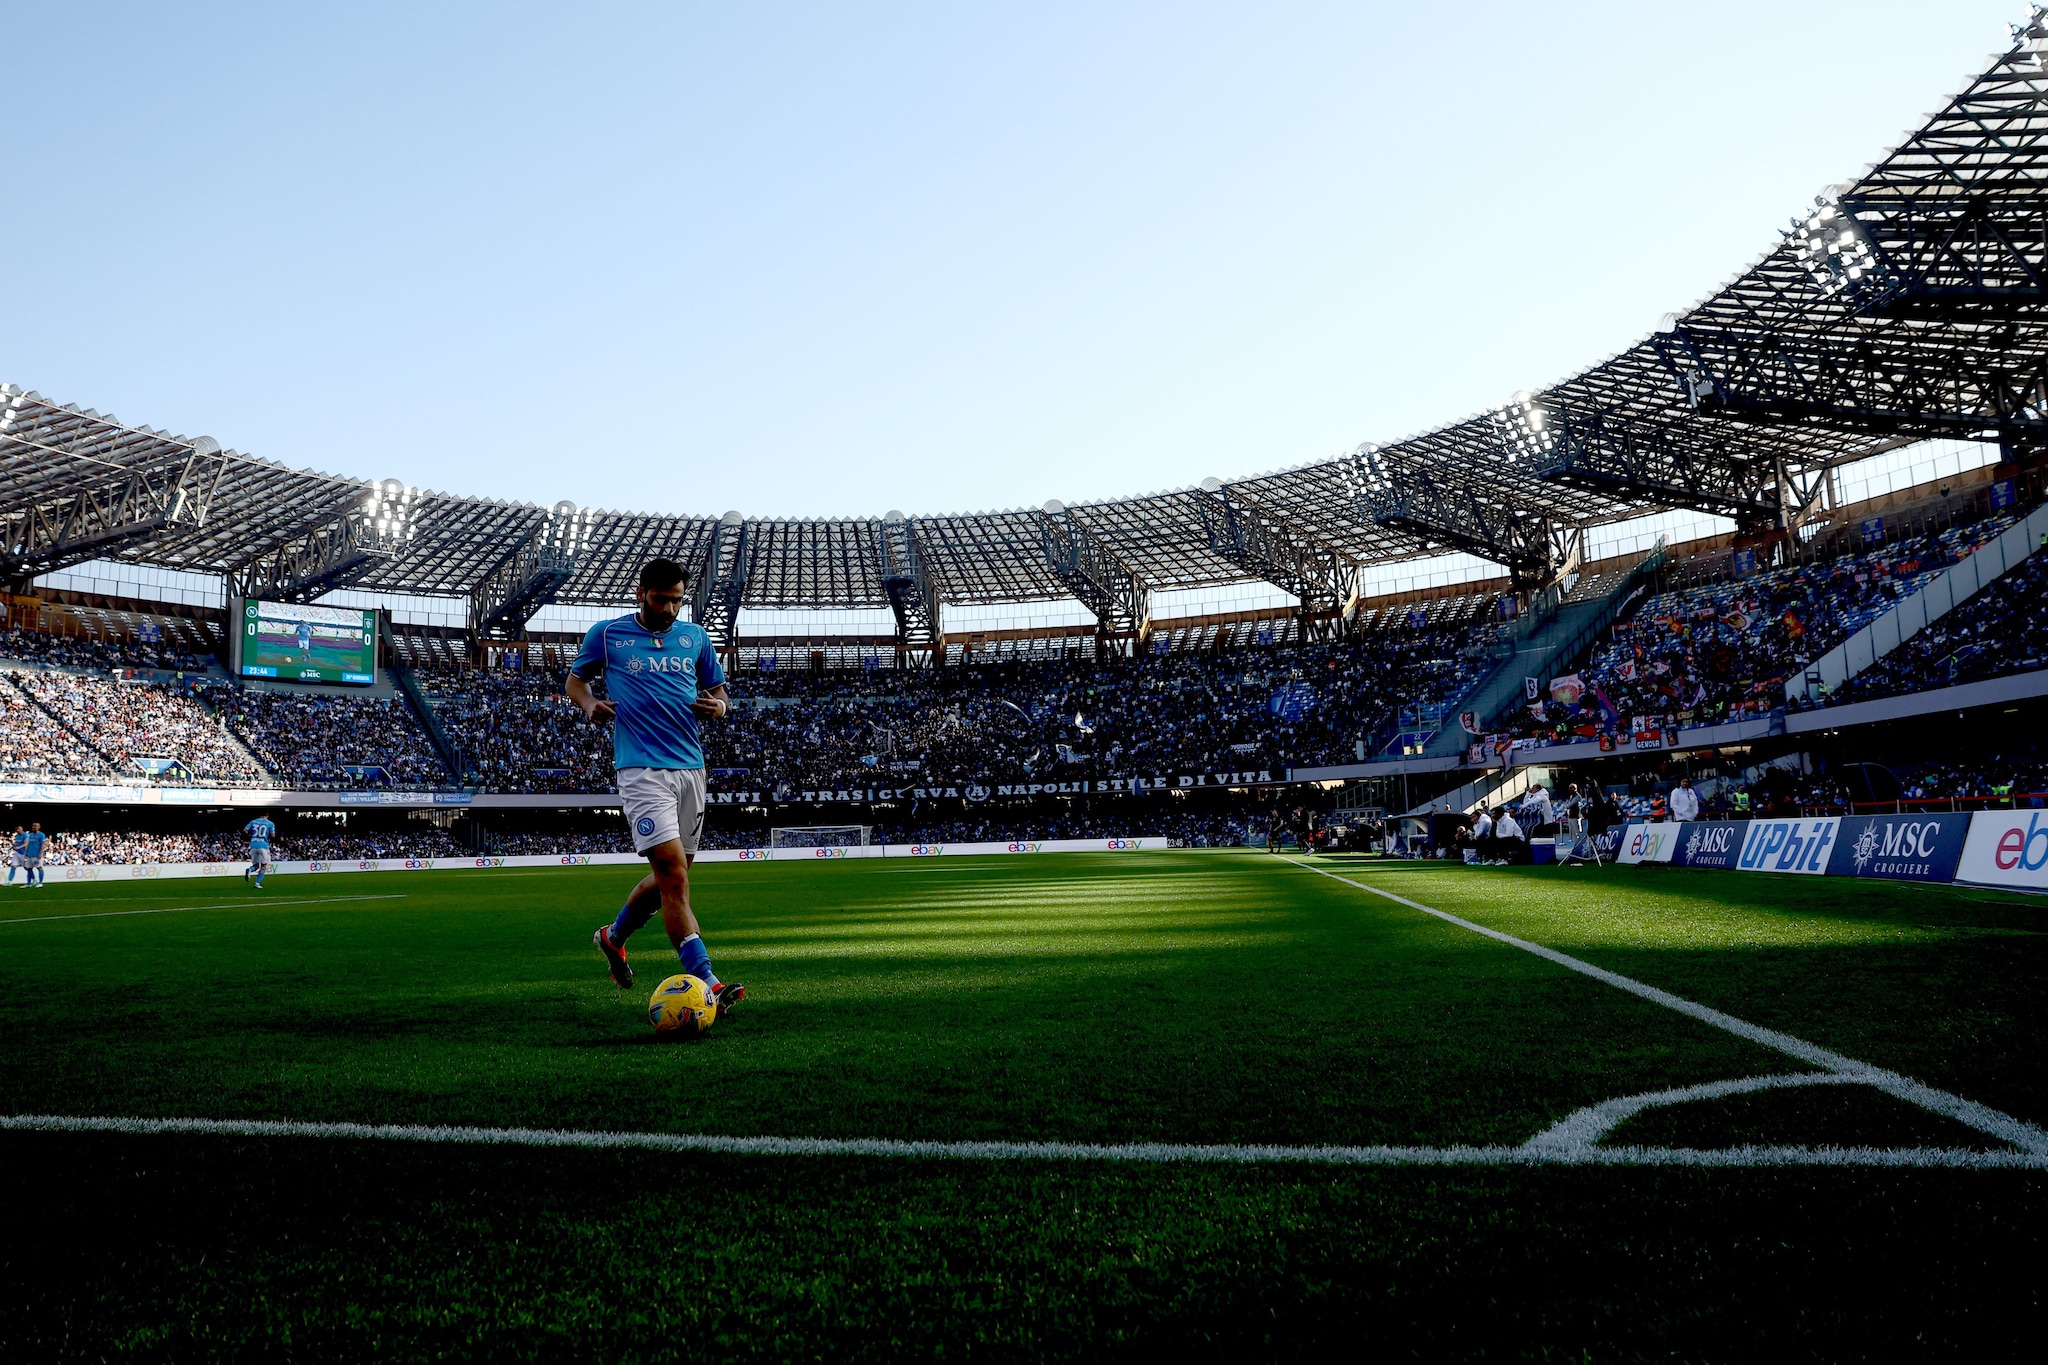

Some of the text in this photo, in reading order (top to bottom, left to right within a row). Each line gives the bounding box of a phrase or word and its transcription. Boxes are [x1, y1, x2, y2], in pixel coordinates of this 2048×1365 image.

[248, 623, 255, 635] 0
[364, 634, 371, 645] 0
[615, 639, 636, 648] EA7
[1017, 652, 1055, 660] SEMPRE
[647, 656, 693, 673] MSC
[1636, 739, 1660, 749] GENOVA
[1179, 774, 1206, 788] DI
[1211, 770, 1272, 784] VITA
[772, 790, 863, 802] UTRAS
[997, 781, 1080, 796] NAPOLI
[252, 824, 267, 837] 30
[691, 812, 704, 837] 7
[1107, 838, 1143, 850] ebay
[1631, 825, 1666, 860] ebay
[1700, 826, 1735, 853] MSC
[1878, 821, 1941, 858] MSC
[816, 847, 848, 859] ebay
[911, 844, 944, 857] ebay
[1008, 841, 1042, 854] ebay
[561, 854, 591, 867] ebay
[739, 849, 771, 861] ebay
[1695, 855, 1727, 865] CROCIERE
[310, 860, 331, 873] ebay
[359, 860, 380, 872] ebay
[405, 856, 434, 870] ebay
[475, 856, 505, 869] ebay
[1874, 862, 1930, 875] CROCIERE
[66, 867, 100, 880] ebay
[131, 864, 164, 878] ebay
[202, 863, 230, 876] ebay
